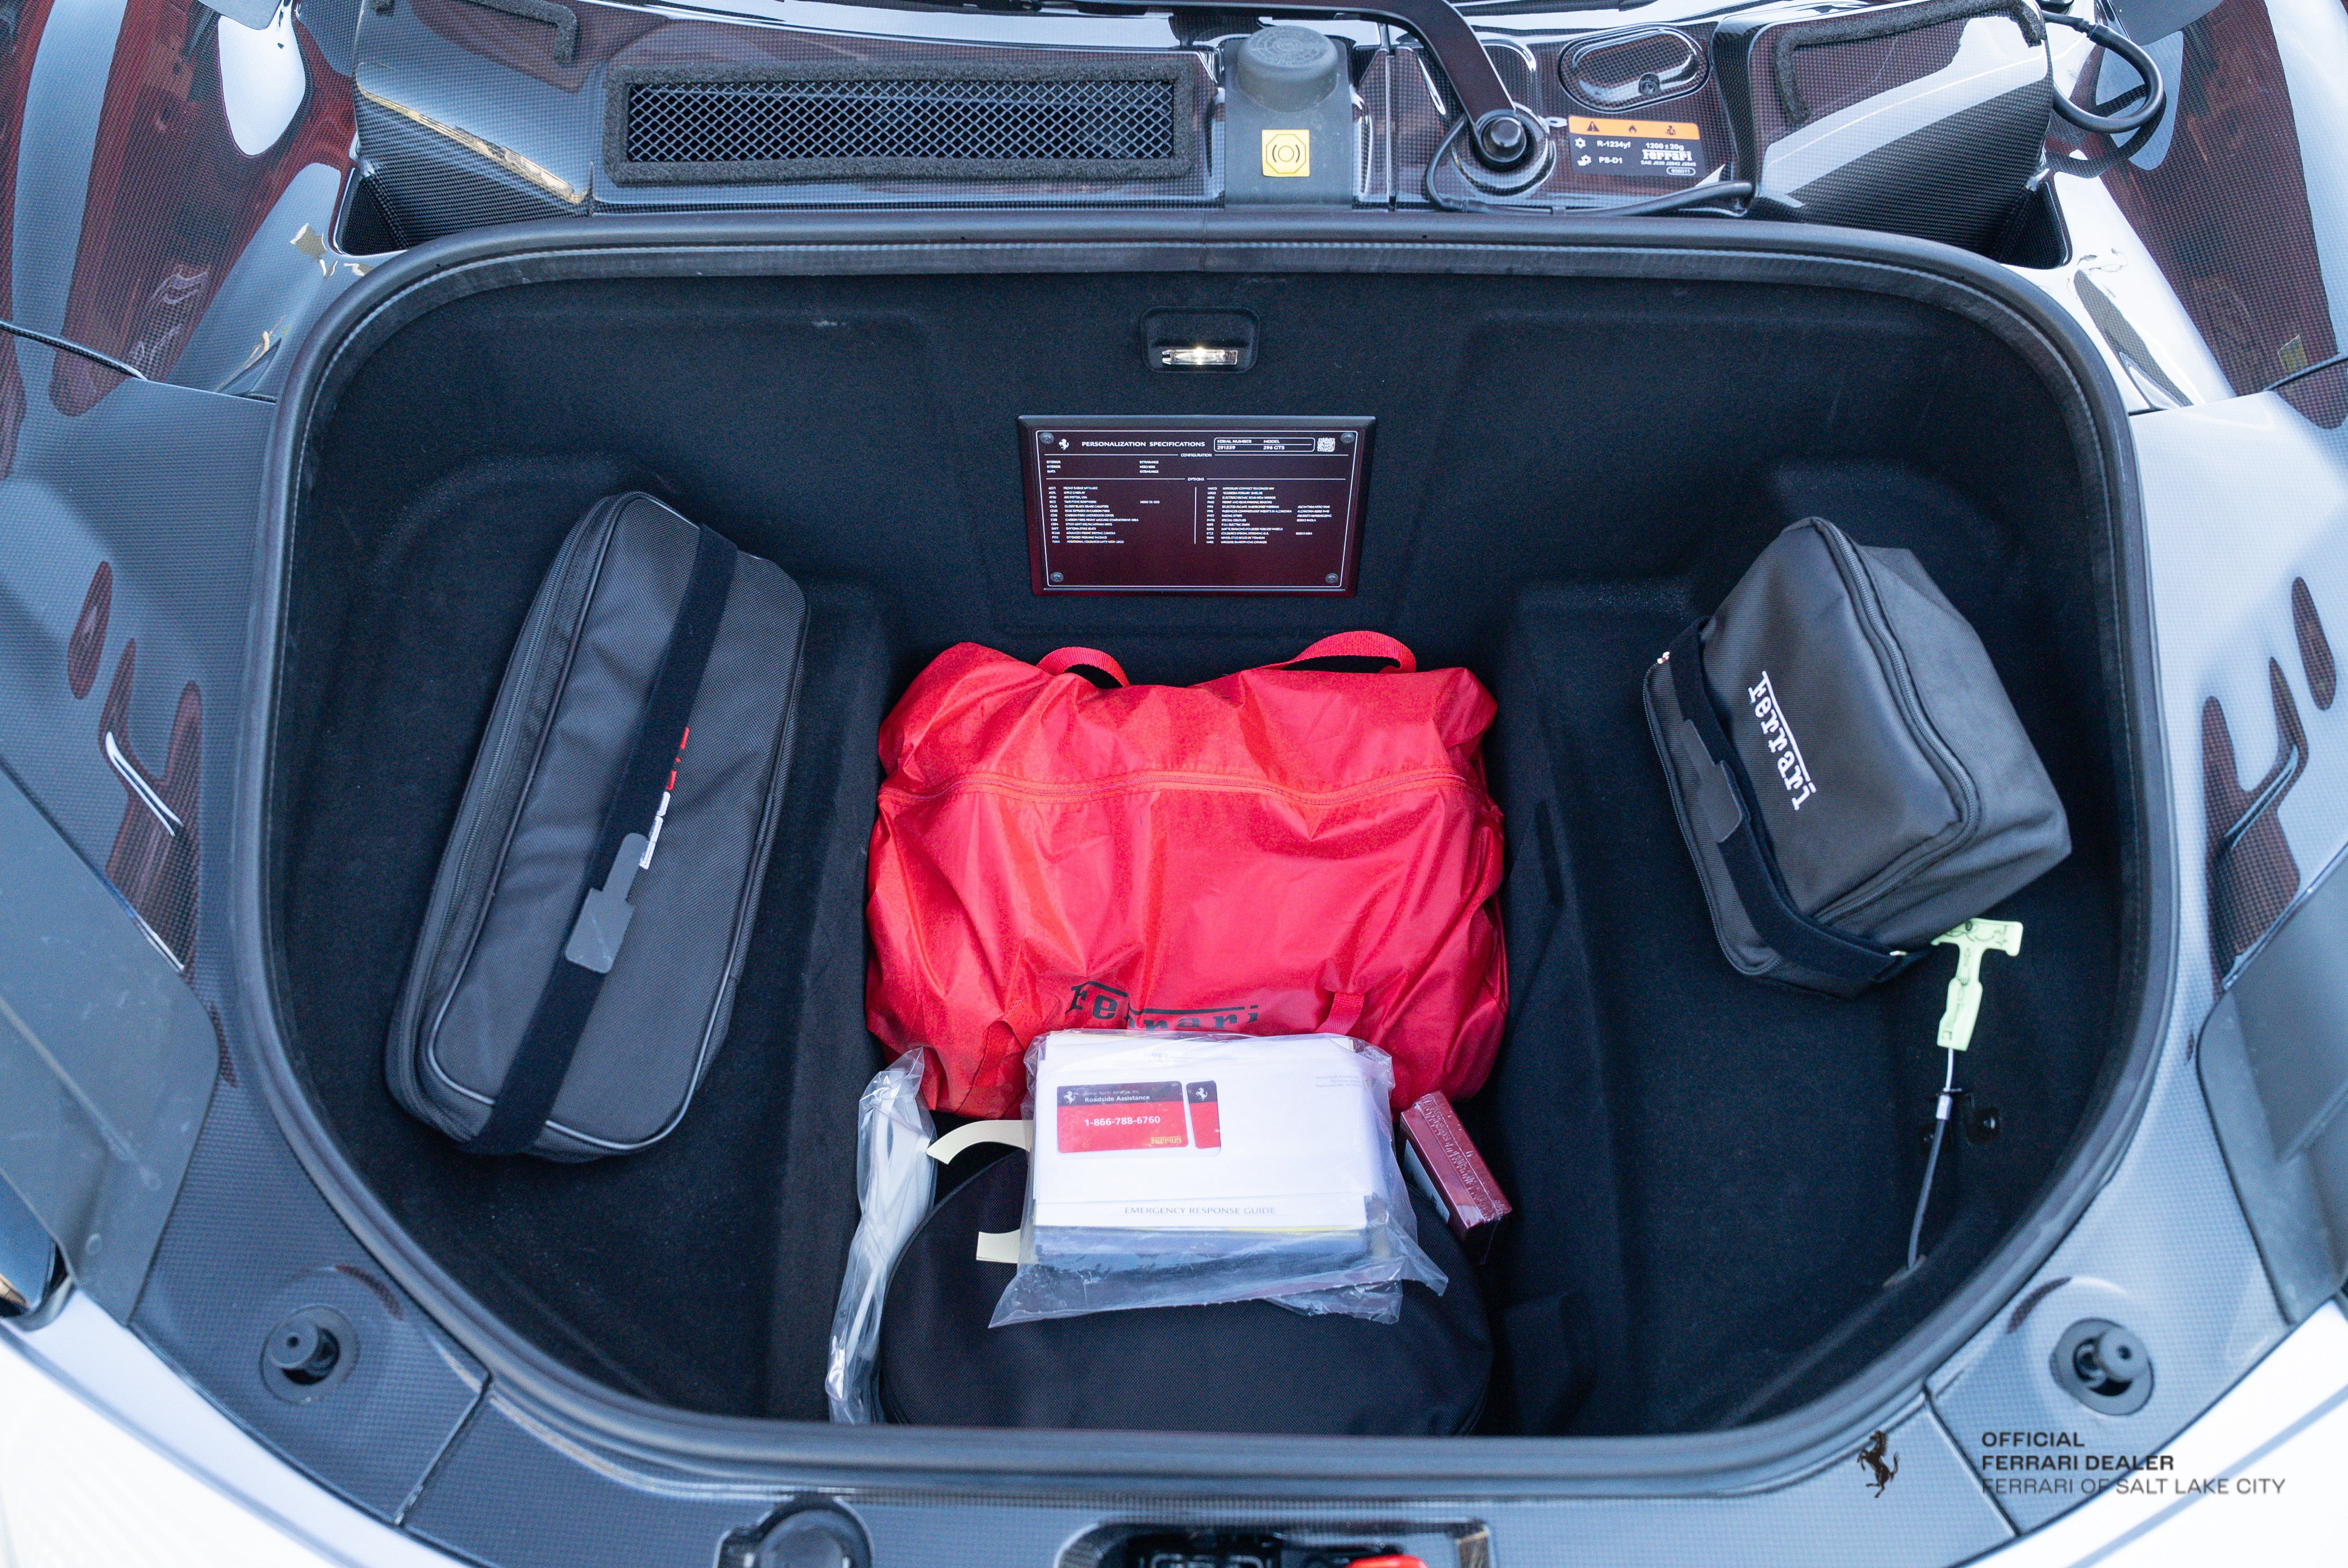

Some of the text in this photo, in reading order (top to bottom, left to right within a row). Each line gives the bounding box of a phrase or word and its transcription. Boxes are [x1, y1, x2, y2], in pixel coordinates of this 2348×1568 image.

[1597, 140, 1631, 149] R-1234yf
[1642, 149, 1692, 161] Ferrari
[1748, 670, 1816, 811] Ferrari
[1084, 1116, 1160, 1127] 1-866-788-6760
[1150, 1136, 1182, 1145] Ferrari
